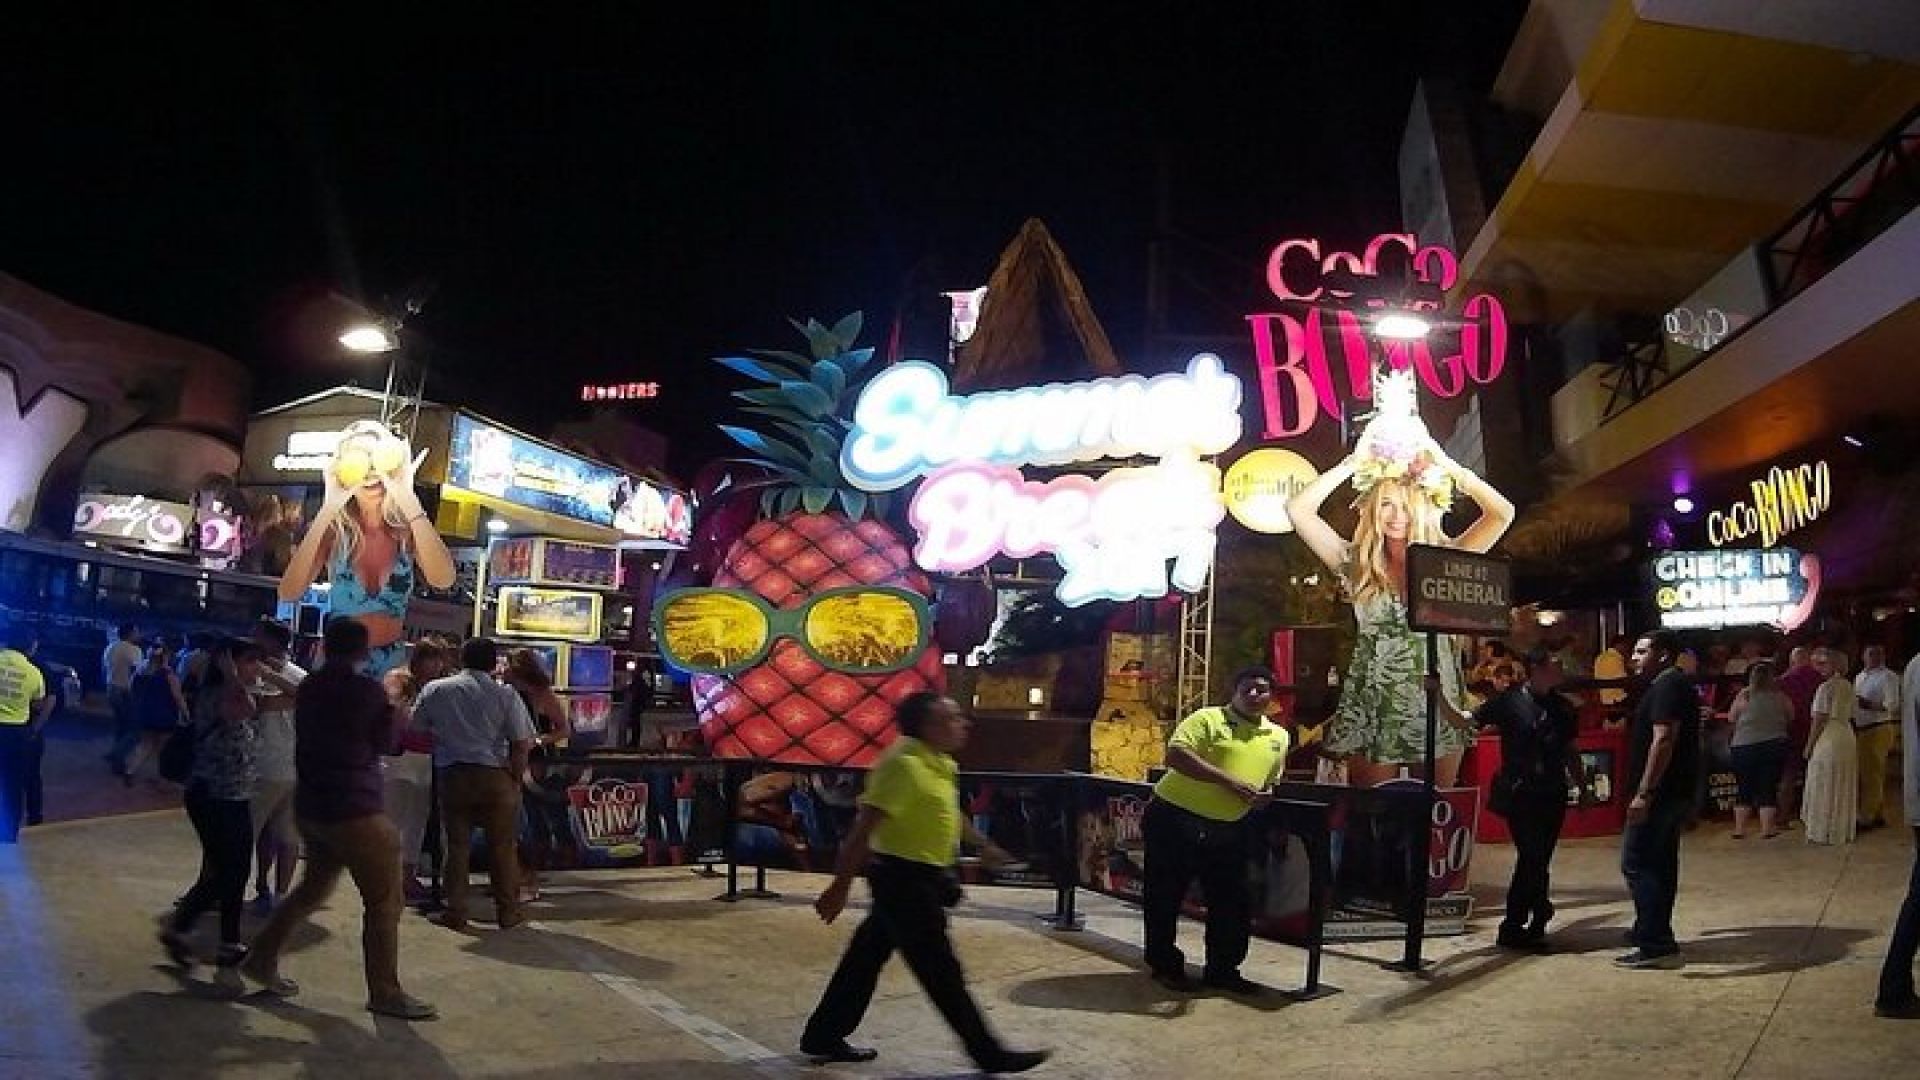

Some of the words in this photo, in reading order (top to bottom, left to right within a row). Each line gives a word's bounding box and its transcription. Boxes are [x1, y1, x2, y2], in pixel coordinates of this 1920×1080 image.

[582, 382, 661, 401] HOOTERS
[1751, 460, 1830, 548] BONGO
[909, 448, 1226, 594] Bre
[1655, 554, 1751, 581] CHECK
[1762, 552, 1792, 576] IN
[1421, 577, 1506, 606] GENERAL
